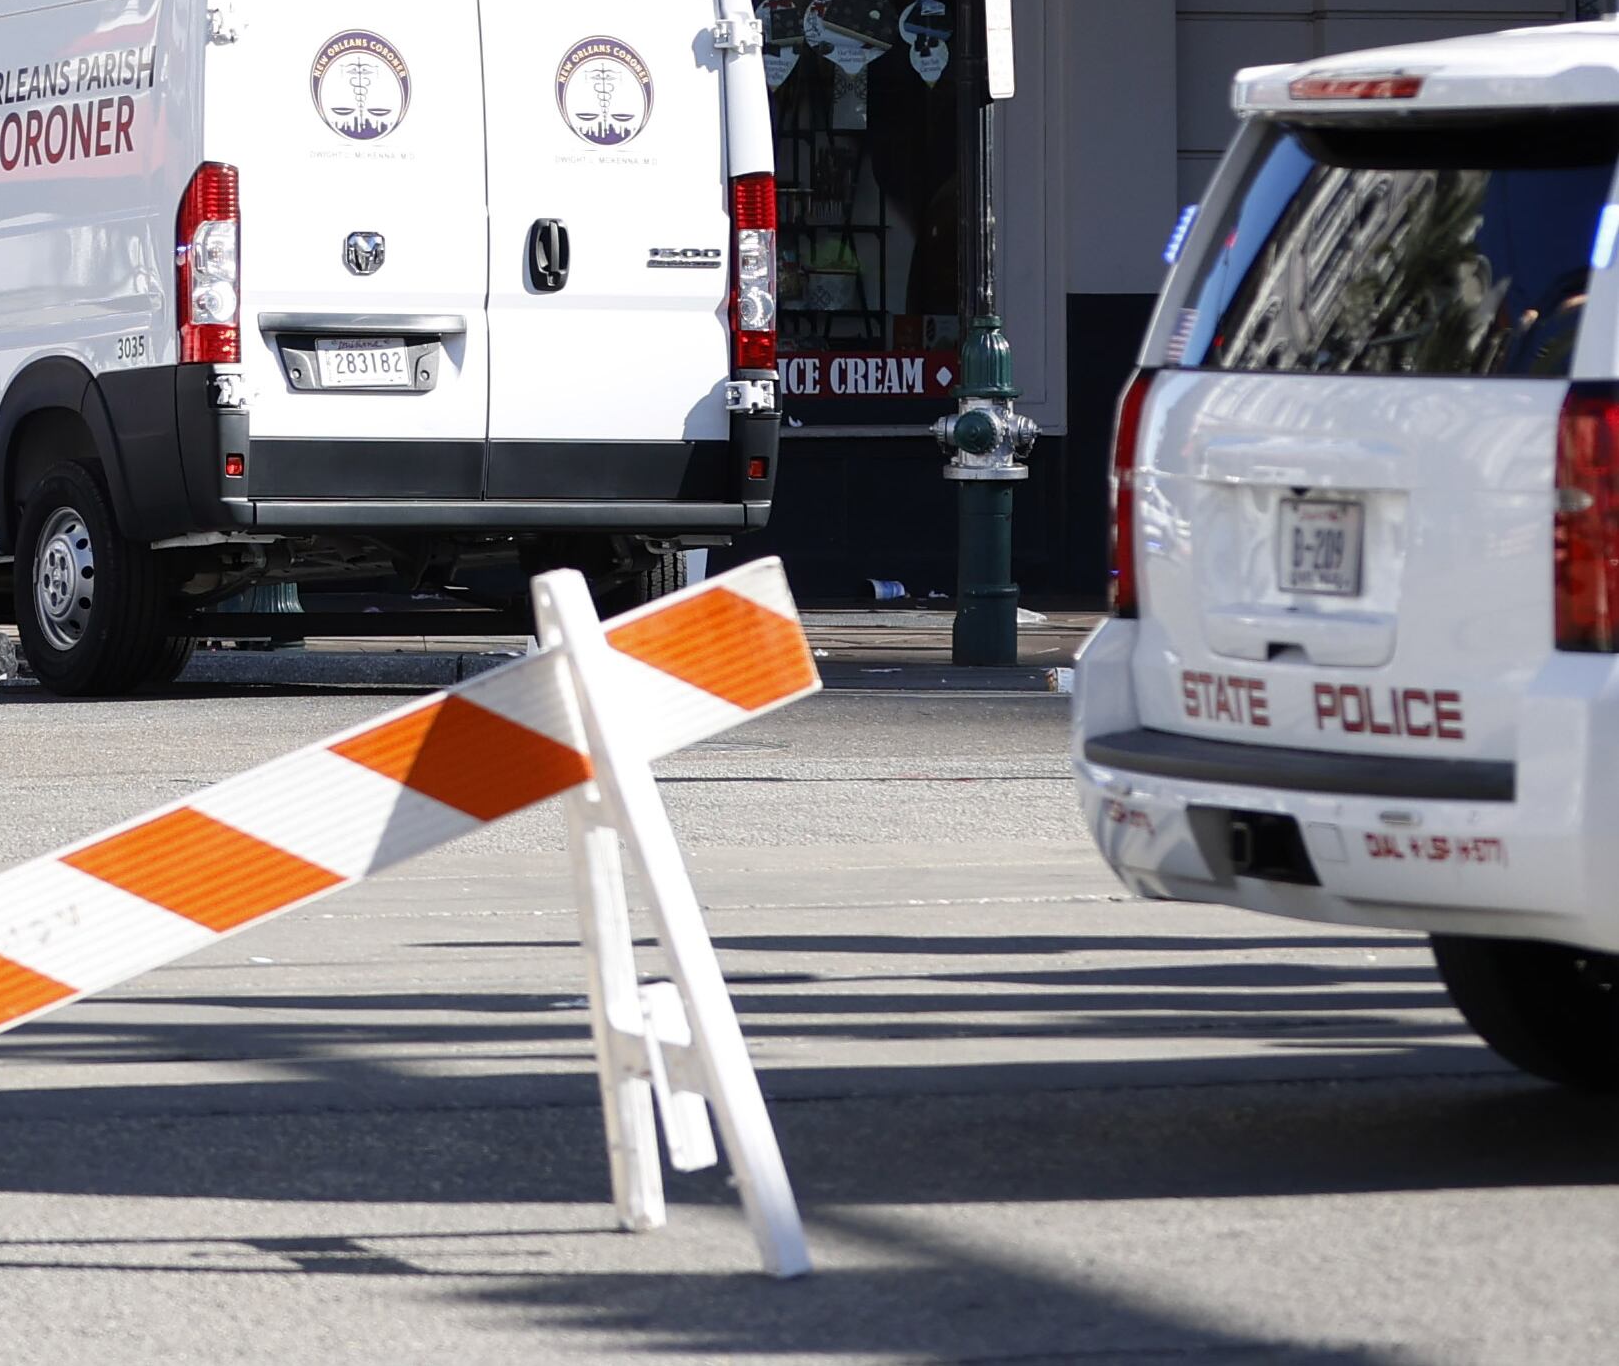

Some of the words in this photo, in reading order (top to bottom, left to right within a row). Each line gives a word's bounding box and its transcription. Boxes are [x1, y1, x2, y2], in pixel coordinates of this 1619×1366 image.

[75, 45, 157, 93] PARISH
[313, 55, 329, 78] NEW
[327, 38, 368, 57] ORLEANS
[369, 41, 406, 78] CORONER
[558, 61, 573, 84] NEW
[571, 44, 611, 62] ORLEANS
[613, 47, 650, 84] CORONER
[116, 335, 146, 360] 3035
[334, 351, 404, 374] 283182
[776, 357, 821, 395] ICE
[830, 357, 925, 395] CREAM
[1182, 670, 1271, 728] STATE
[1313, 681, 1466, 741] POLICE
